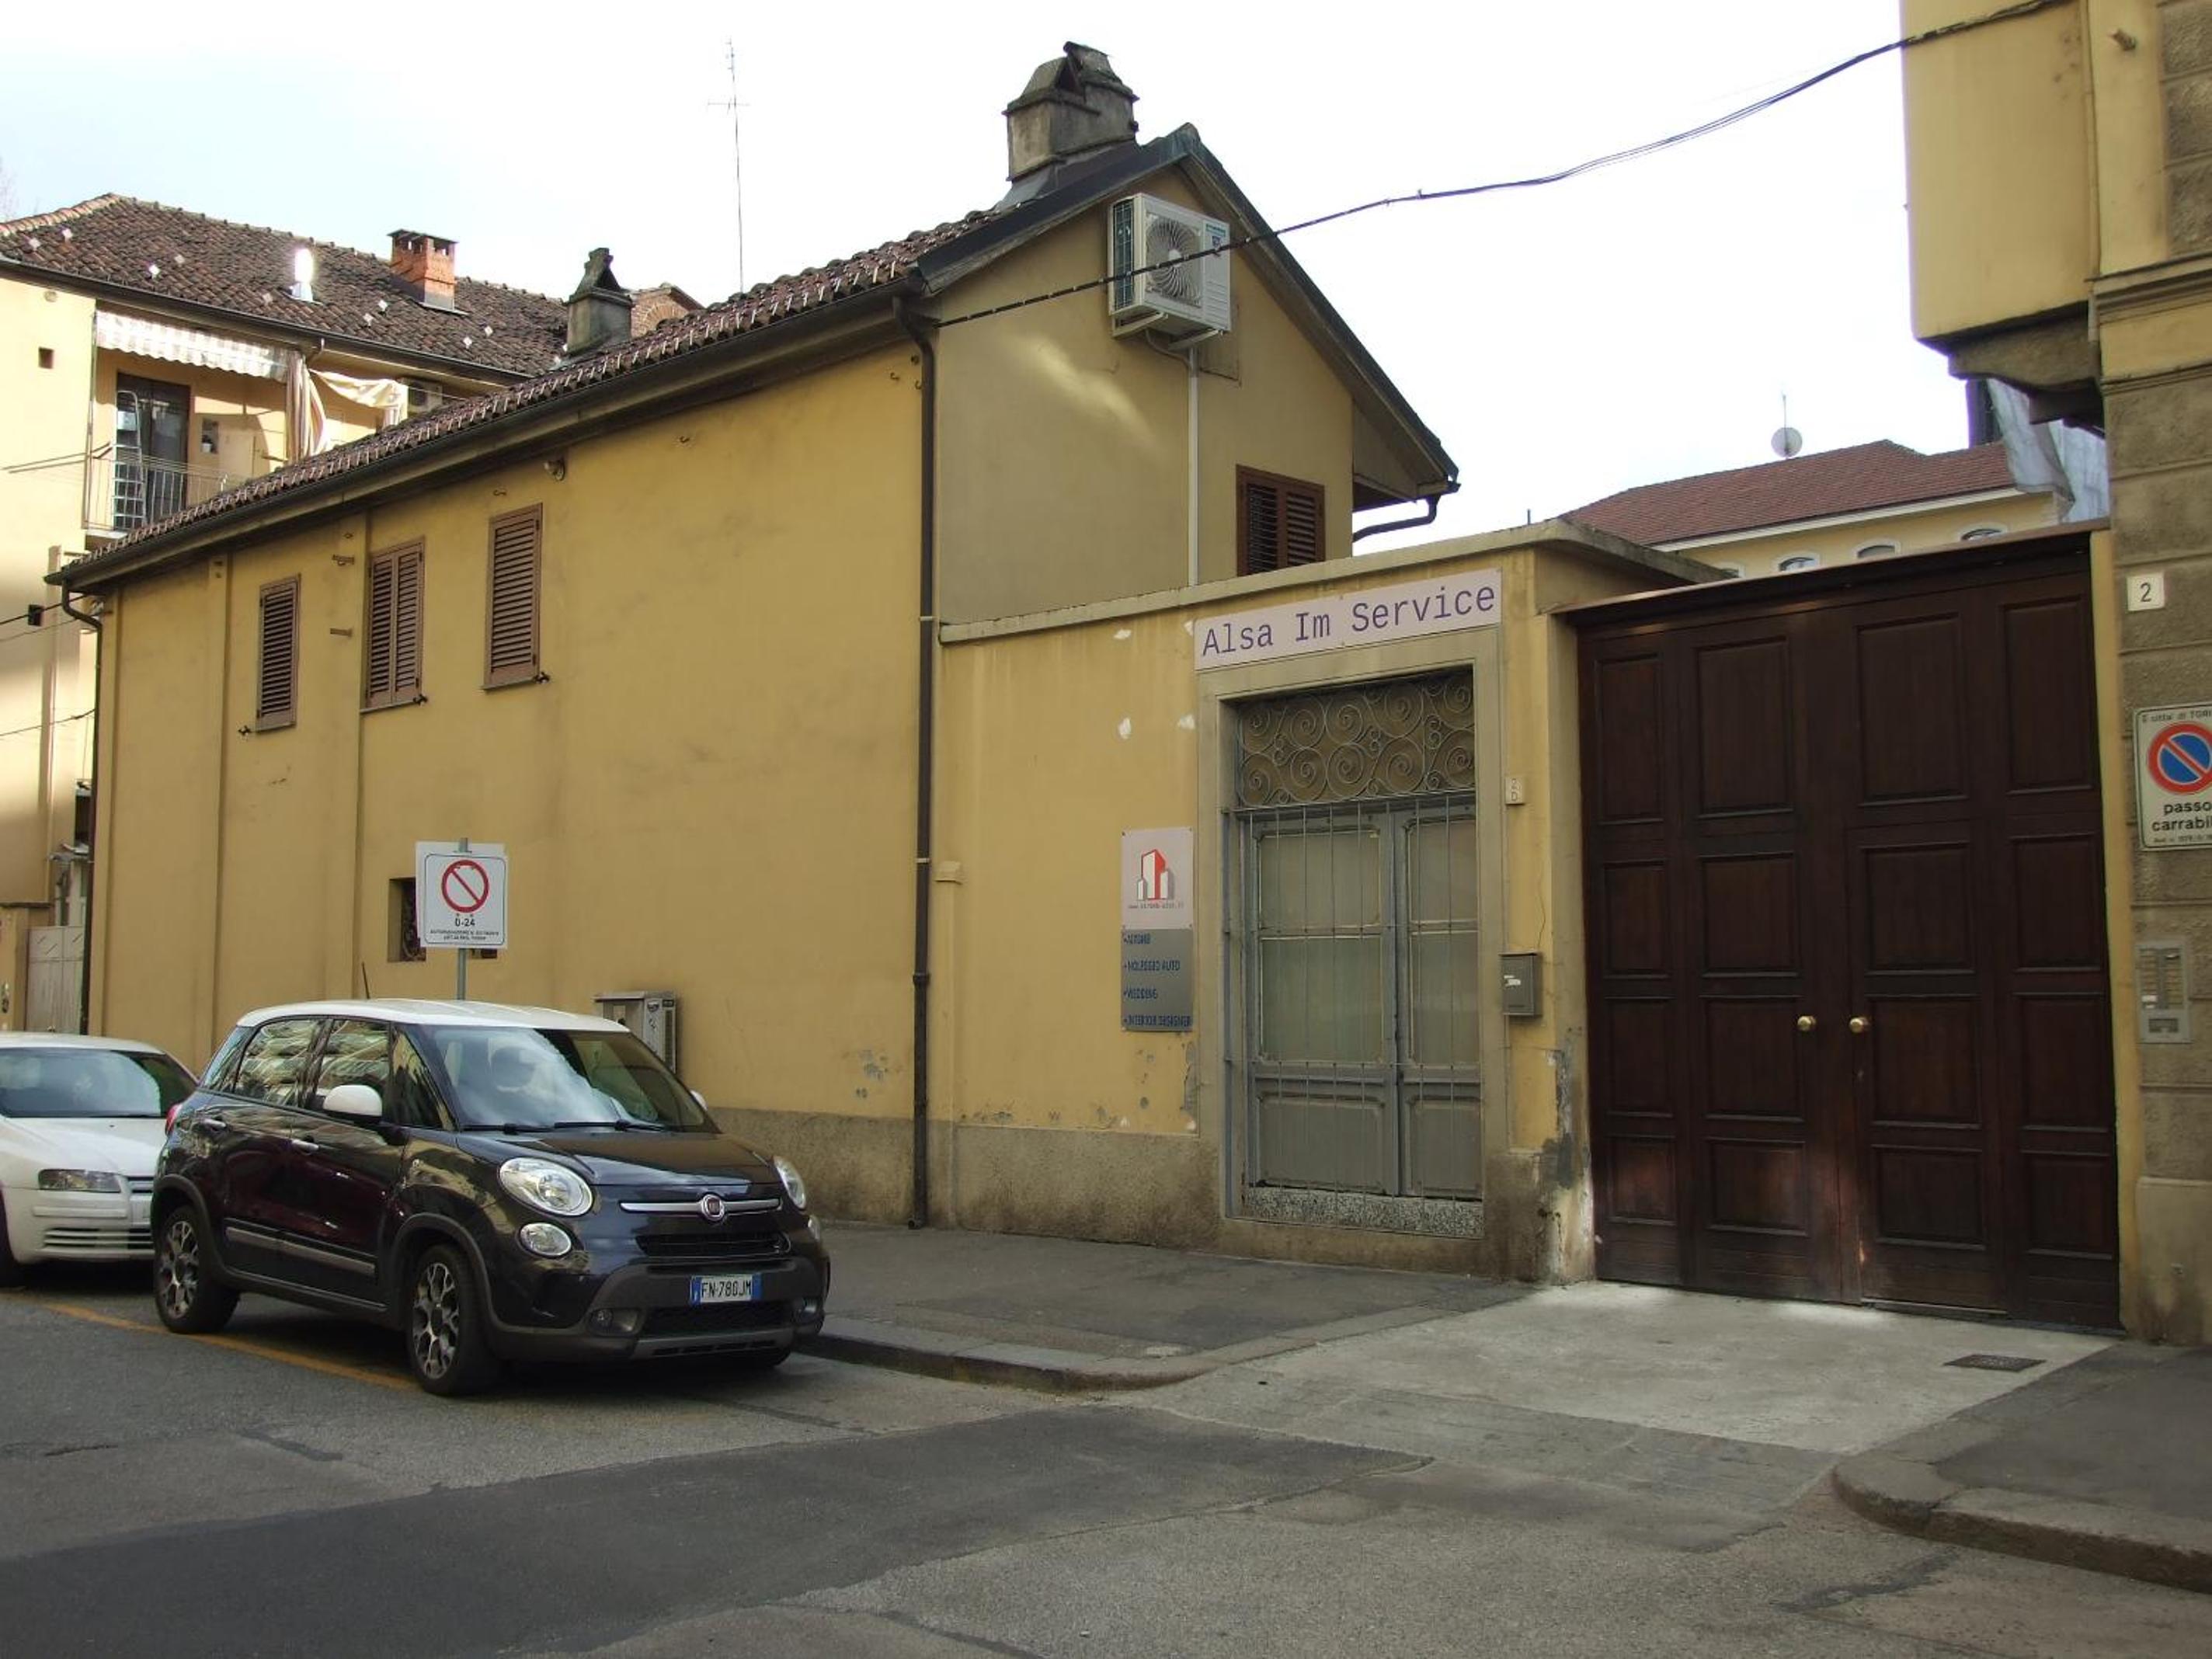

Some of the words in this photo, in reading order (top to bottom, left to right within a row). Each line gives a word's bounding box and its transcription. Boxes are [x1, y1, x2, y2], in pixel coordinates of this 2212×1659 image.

[2140, 582, 2152, 603] 2
[1202, 623, 1274, 656] Alsa
[1295, 612, 1330, 642] Im
[1351, 585, 1495, 633] Service
[2163, 801, 2212, 816] passo
[1162, 958, 1181, 972] AUTO
